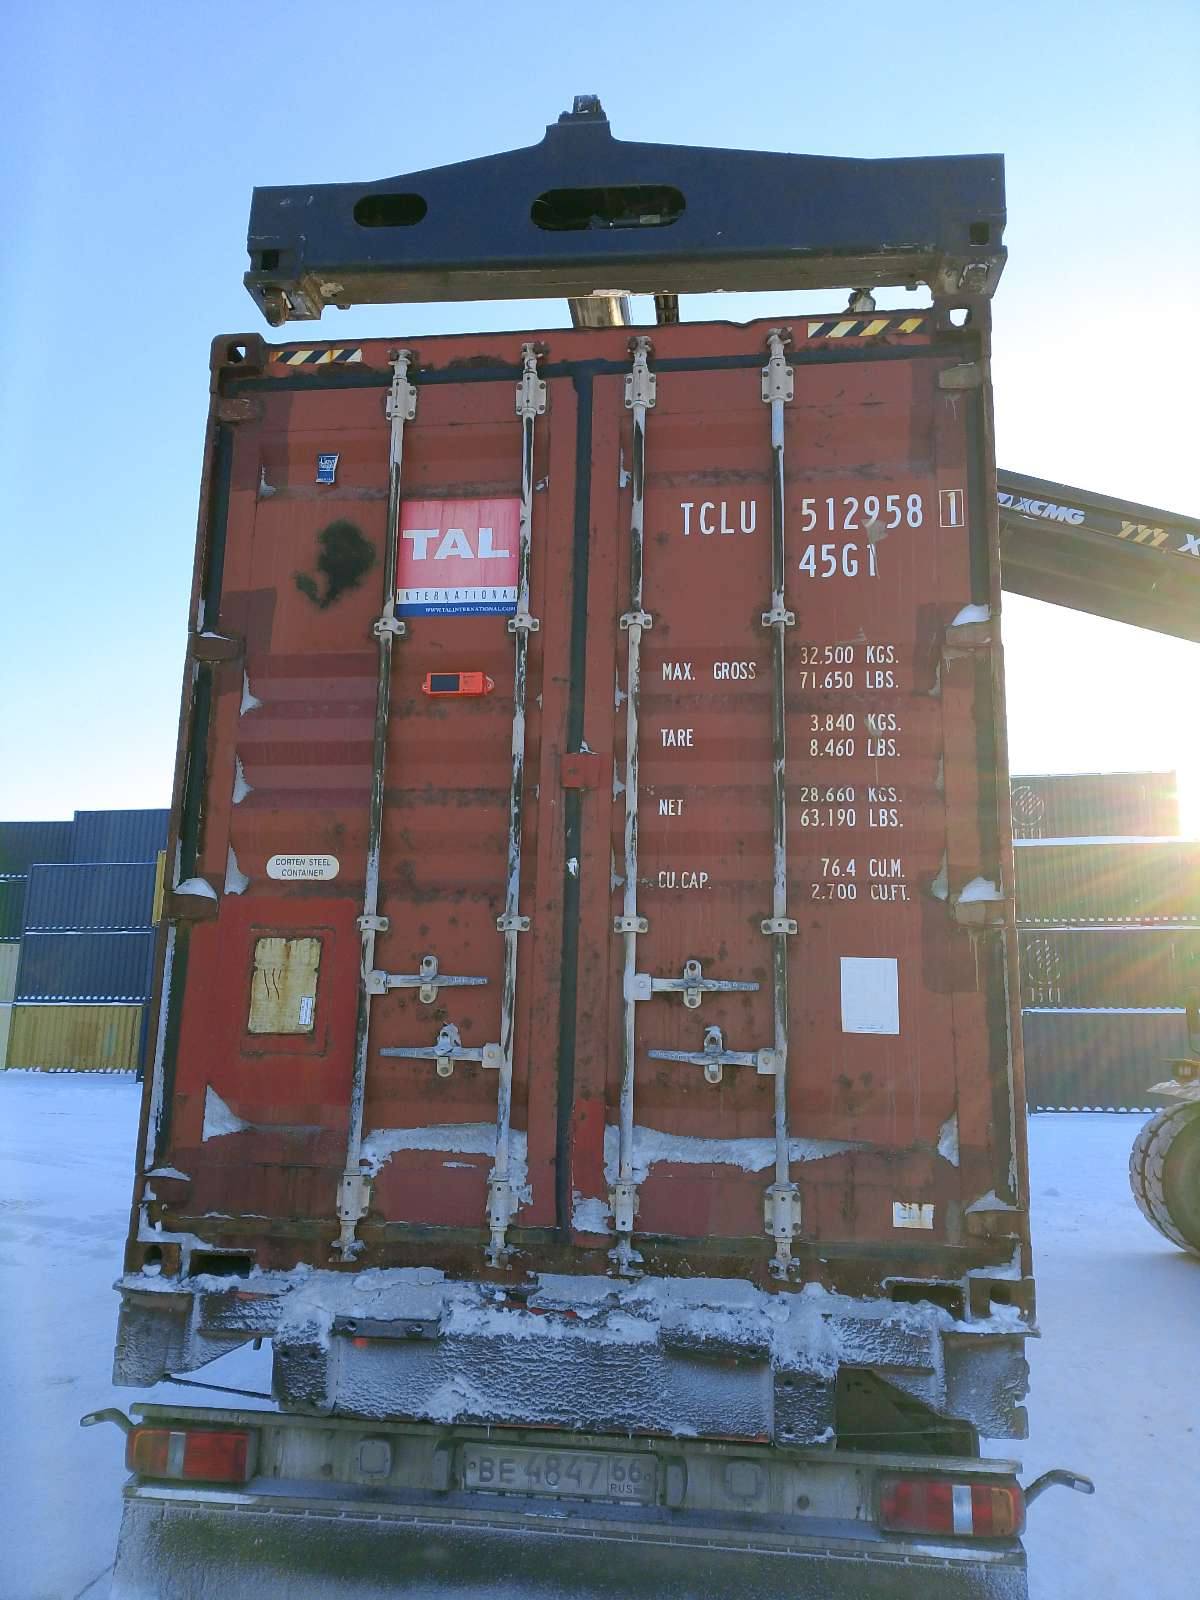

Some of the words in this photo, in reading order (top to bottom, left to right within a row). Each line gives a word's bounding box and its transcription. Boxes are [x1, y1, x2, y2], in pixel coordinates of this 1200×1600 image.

[680, 500, 756, 536] TCLU
[801, 493, 923, 532] 512958
[943, 490, 960, 526] 1
[1011, 497, 1086, 525] XCMG
[402, 527, 510, 561] TAL
[799, 543, 877, 578] 45G1
[397, 589, 517, 601] INTERNATIONAL
[800, 646, 854, 665] 32.500
[866, 645, 899, 664] KGS.
[662, 662, 696, 681] MAX.
[713, 662, 757, 680] GROSS
[800, 671, 854, 689] 71.650
[866, 670, 899, 689] LBS.
[810, 713, 855, 732] 3.840
[867, 713, 902, 731] KGS.
[660, 728, 694, 747] TARE
[810, 738, 855, 757] 8.460
[867, 738, 901, 757] LBS.
[800, 787, 855, 802] 28.660
[868, 787, 903, 802] KGS.
[658, 799, 684, 816] NET
[800, 808, 856, 827] 63.190
[869, 808, 904, 827] LBS.
[275, 858, 305, 866] CORTEN
[308, 858, 331, 866] STEEL
[821, 857, 856, 877] 76.4
[869, 858, 905, 878] CU.M.
[281, 869, 324, 877] CONTAINER
[658, 871, 712, 889] CU.CAP.
[811, 883, 857, 900] 2.700
[870, 883, 911, 901] CU.FT.
[612, 1456, 642, 1483] 66
[609, 1482, 634, 1494] RUS
